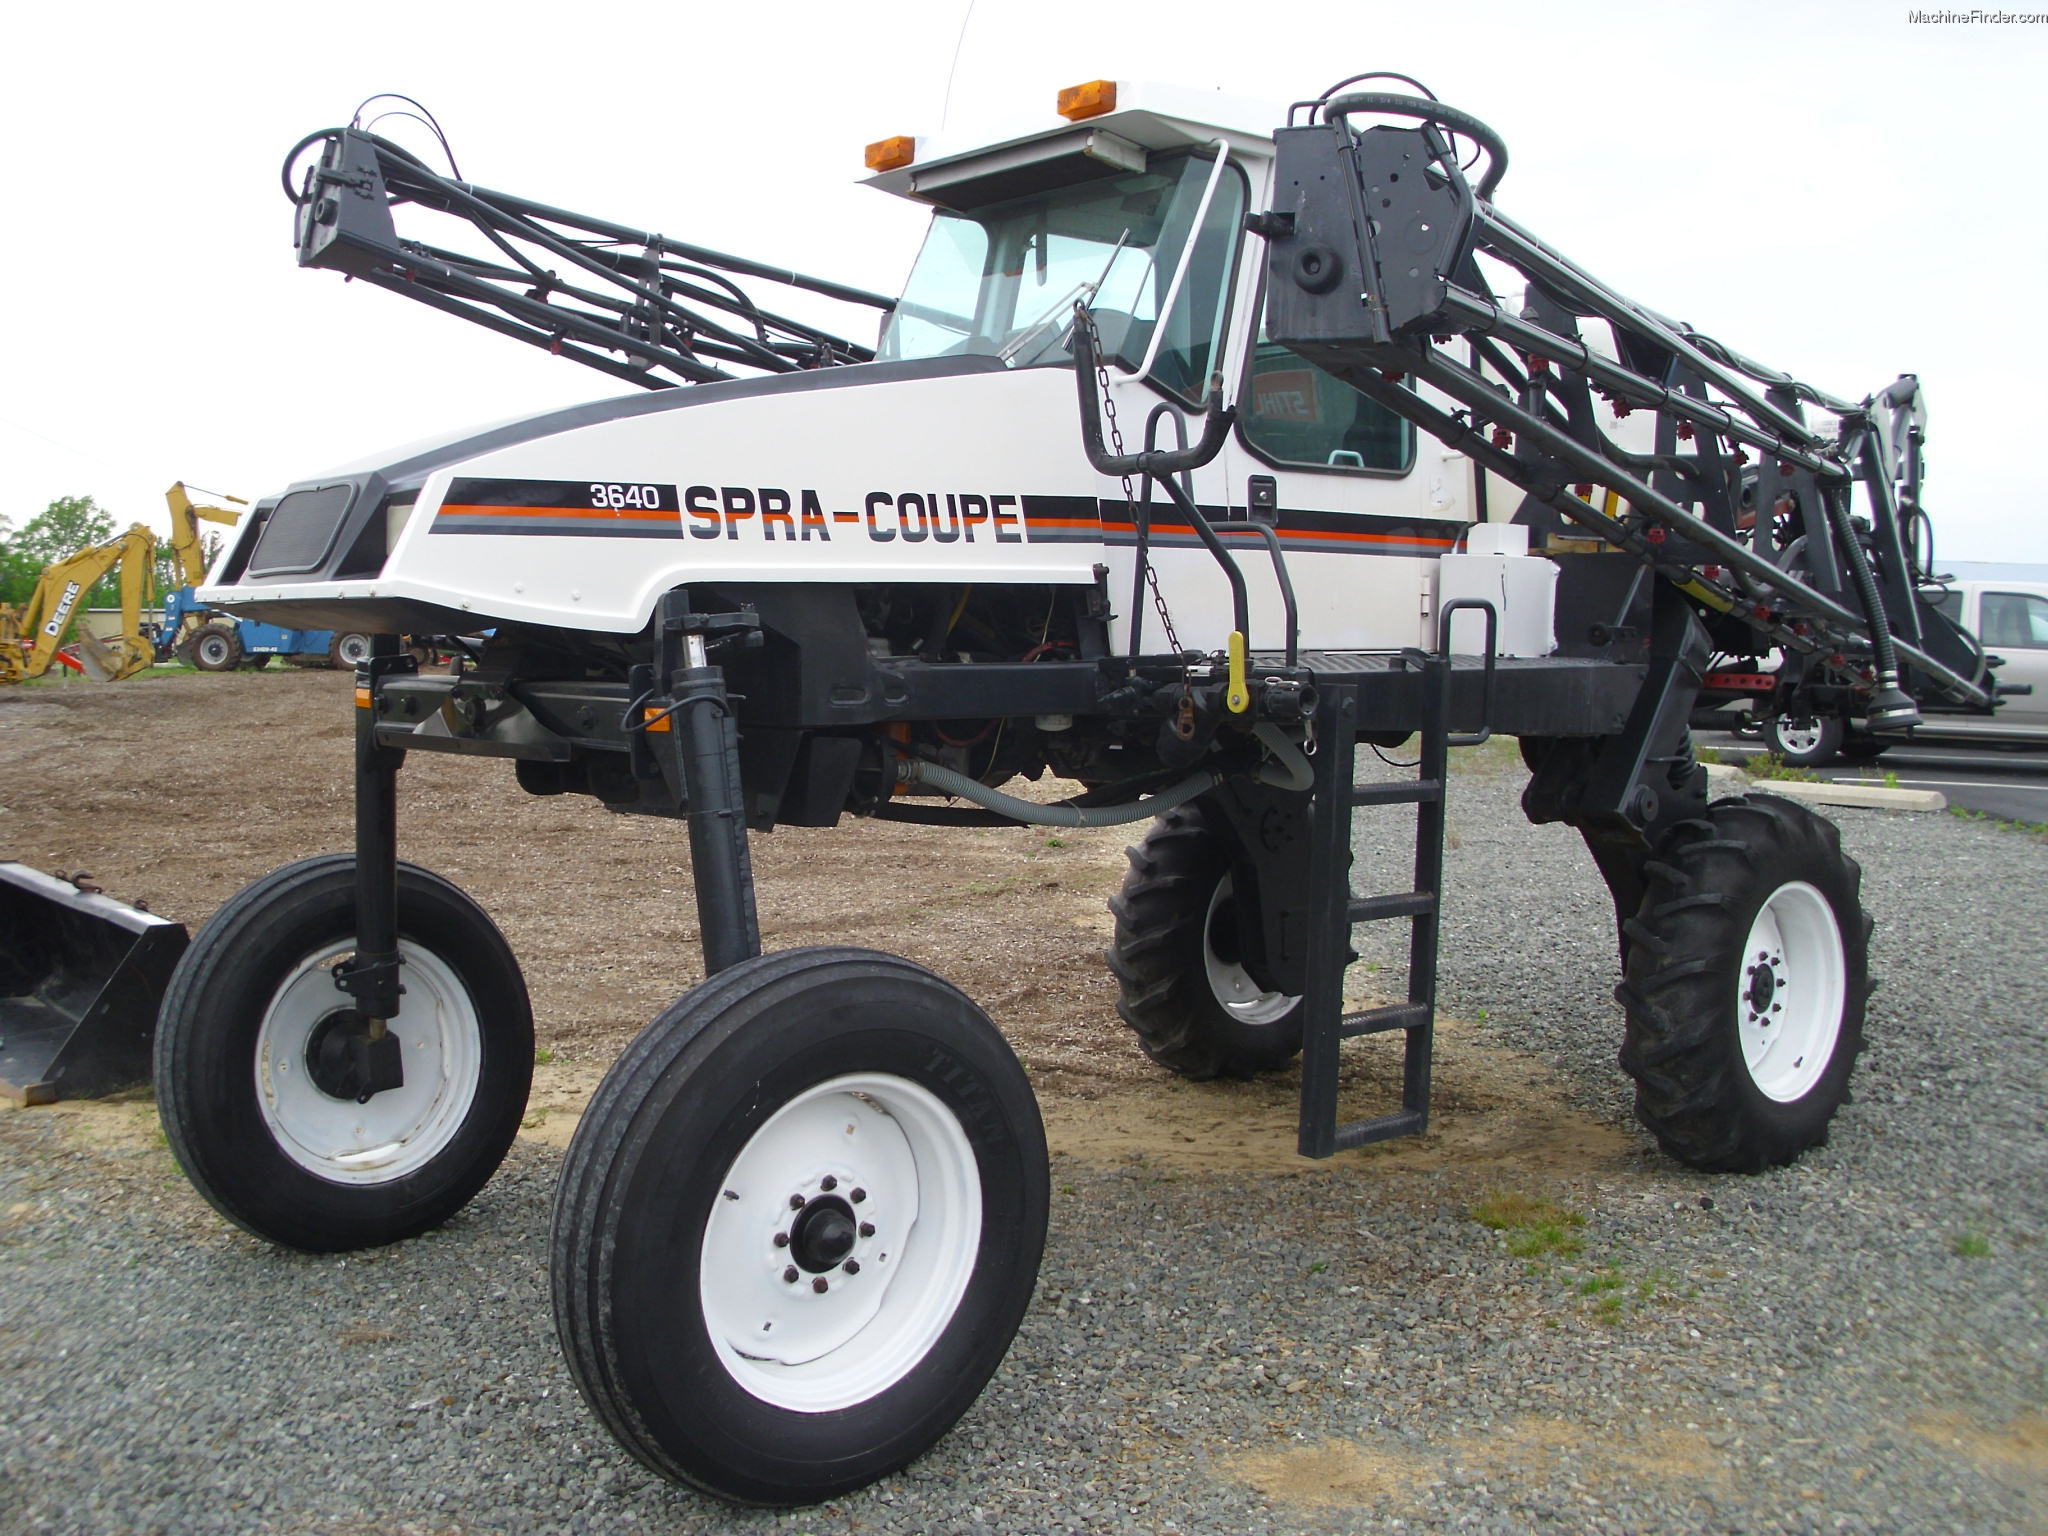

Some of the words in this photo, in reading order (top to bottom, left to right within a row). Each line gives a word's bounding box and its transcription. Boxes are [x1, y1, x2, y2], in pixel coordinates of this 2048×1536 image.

[590, 483, 660, 509] 3640
[684, 485, 1022, 543] SPRA-COUPE
[45, 581, 79, 636] DEERE
